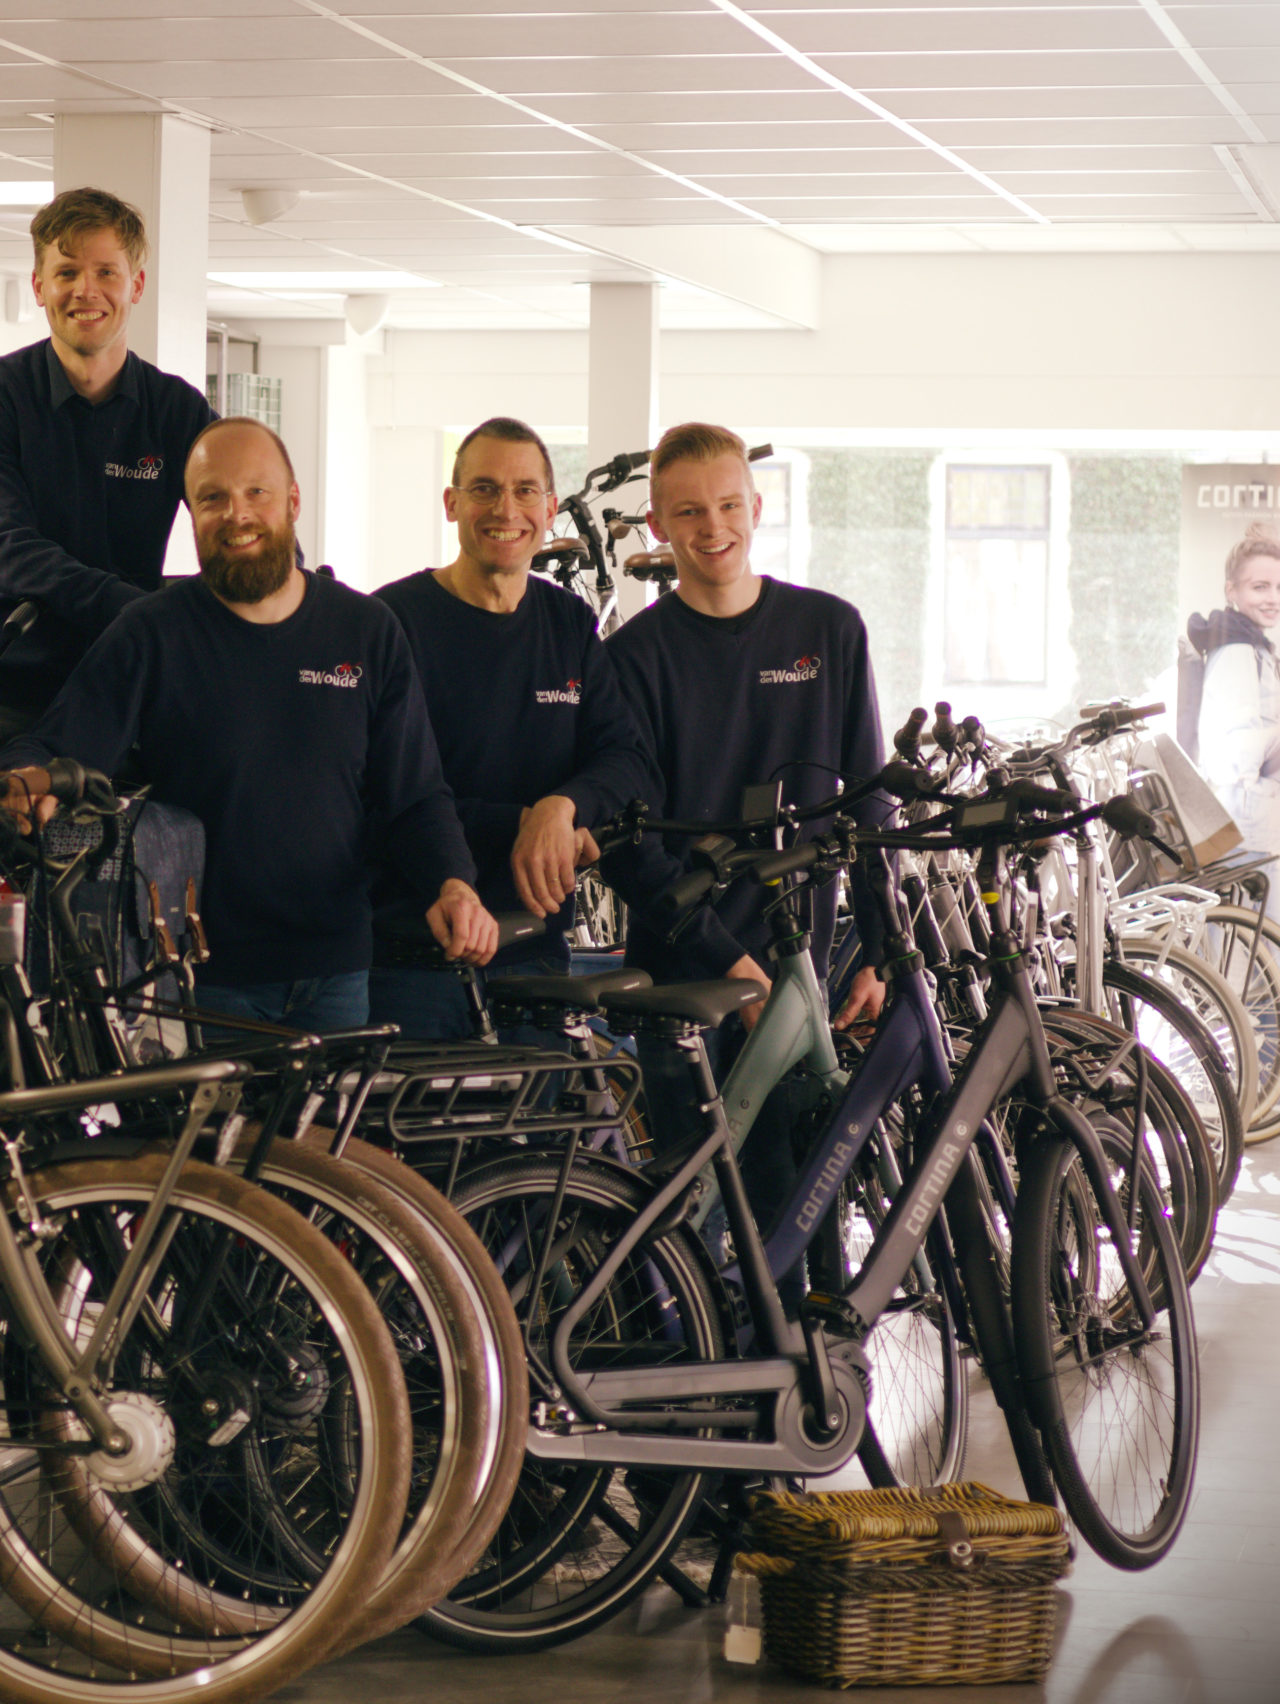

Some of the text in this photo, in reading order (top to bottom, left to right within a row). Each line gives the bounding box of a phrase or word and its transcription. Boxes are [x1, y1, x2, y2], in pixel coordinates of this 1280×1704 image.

[114, 464, 159, 480] Woude
[1198, 485, 1280, 508] CORTI
[311, 671, 358, 688] Woude
[773, 667, 818, 683] Woude
